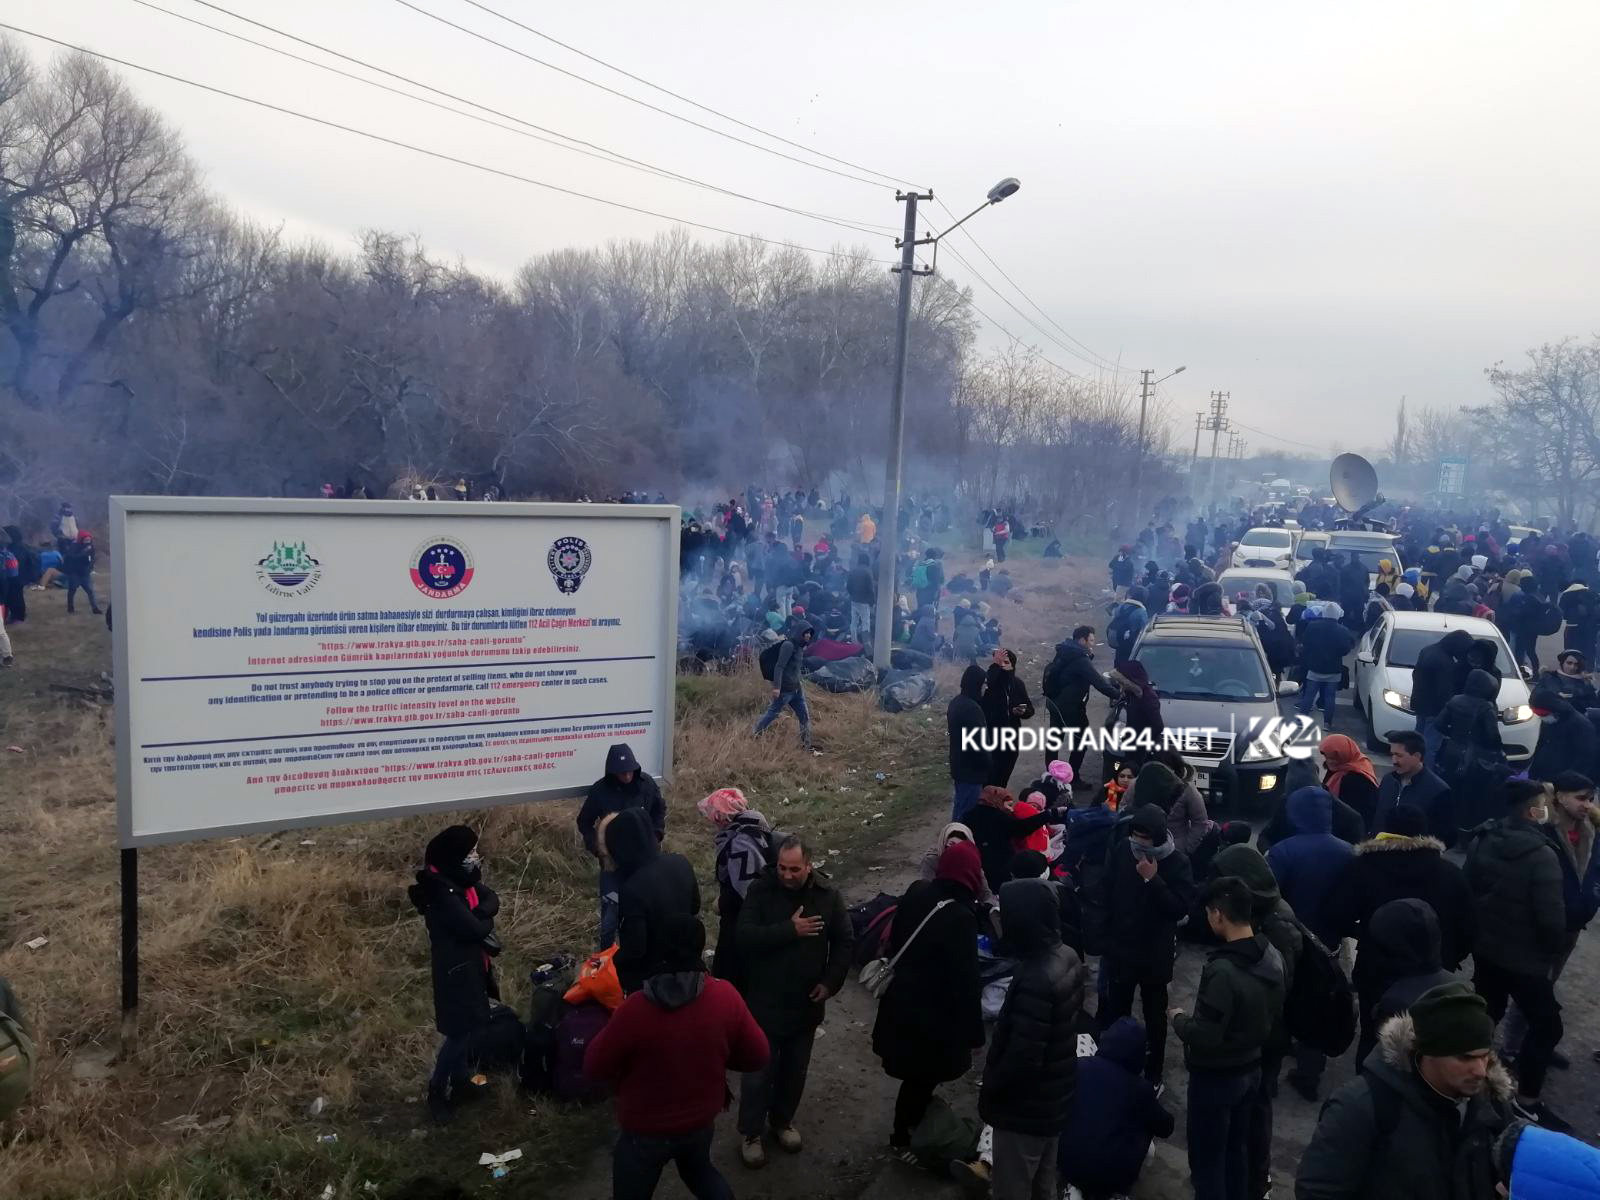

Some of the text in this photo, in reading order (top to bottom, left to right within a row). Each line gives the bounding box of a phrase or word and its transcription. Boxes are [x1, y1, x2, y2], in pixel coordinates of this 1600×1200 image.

[417, 582, 466, 599] JANDARMA
[256, 612, 267, 622] Yol
[306, 611, 337, 621] üzerinde
[339, 611, 355, 621] ürün
[357, 611, 378, 620] satma
[379, 609, 420, 620] bahanesiyle
[422, 609, 432, 619] sizi
[435, 608, 474, 619] durdurmaya
[545, 607, 575, 616] edemeyen
[192, 627, 231, 637] kendisine
[233, 626, 251, 636] Polis
[253, 626, 271, 637] yada
[348, 625, 368, 633] veren
[451, 621, 459, 630] Bu
[461, 621, 470, 630] tür
[471, 620, 508, 630] durumlarda
[509, 619, 527, 629] lütfen
[528, 619, 537, 628] 112
[538, 618, 550, 628] Acil
[288, 654, 337, 663] adresinden
[341, 652, 372, 661] Gümrük
[471, 648, 509, 656] durumunu
[512, 647, 530, 655] takip
[251, 683, 261, 691] Do
[300, 680, 333, 689] anybody
[335, 679, 358, 688] trying
[369, 678, 385, 686] stop
[462, 673, 485, 681] selling
[208, 697, 223, 705] any
[225, 693, 280, 703] identification
[293, 690, 337, 700] pretending
[366, 688, 389, 696] police
[391, 686, 415, 694] officer
[475, 682, 488, 690] call
[490, 681, 500, 689] 112
[502, 681, 539, 689] emergency
[326, 705, 353, 714] Follow
[372, 703, 397, 711] traffic
[400, 701, 435, 710] intensity
[438, 699, 457, 707] level
[486, 696, 515, 704] website
[265, 775, 280, 783] την
